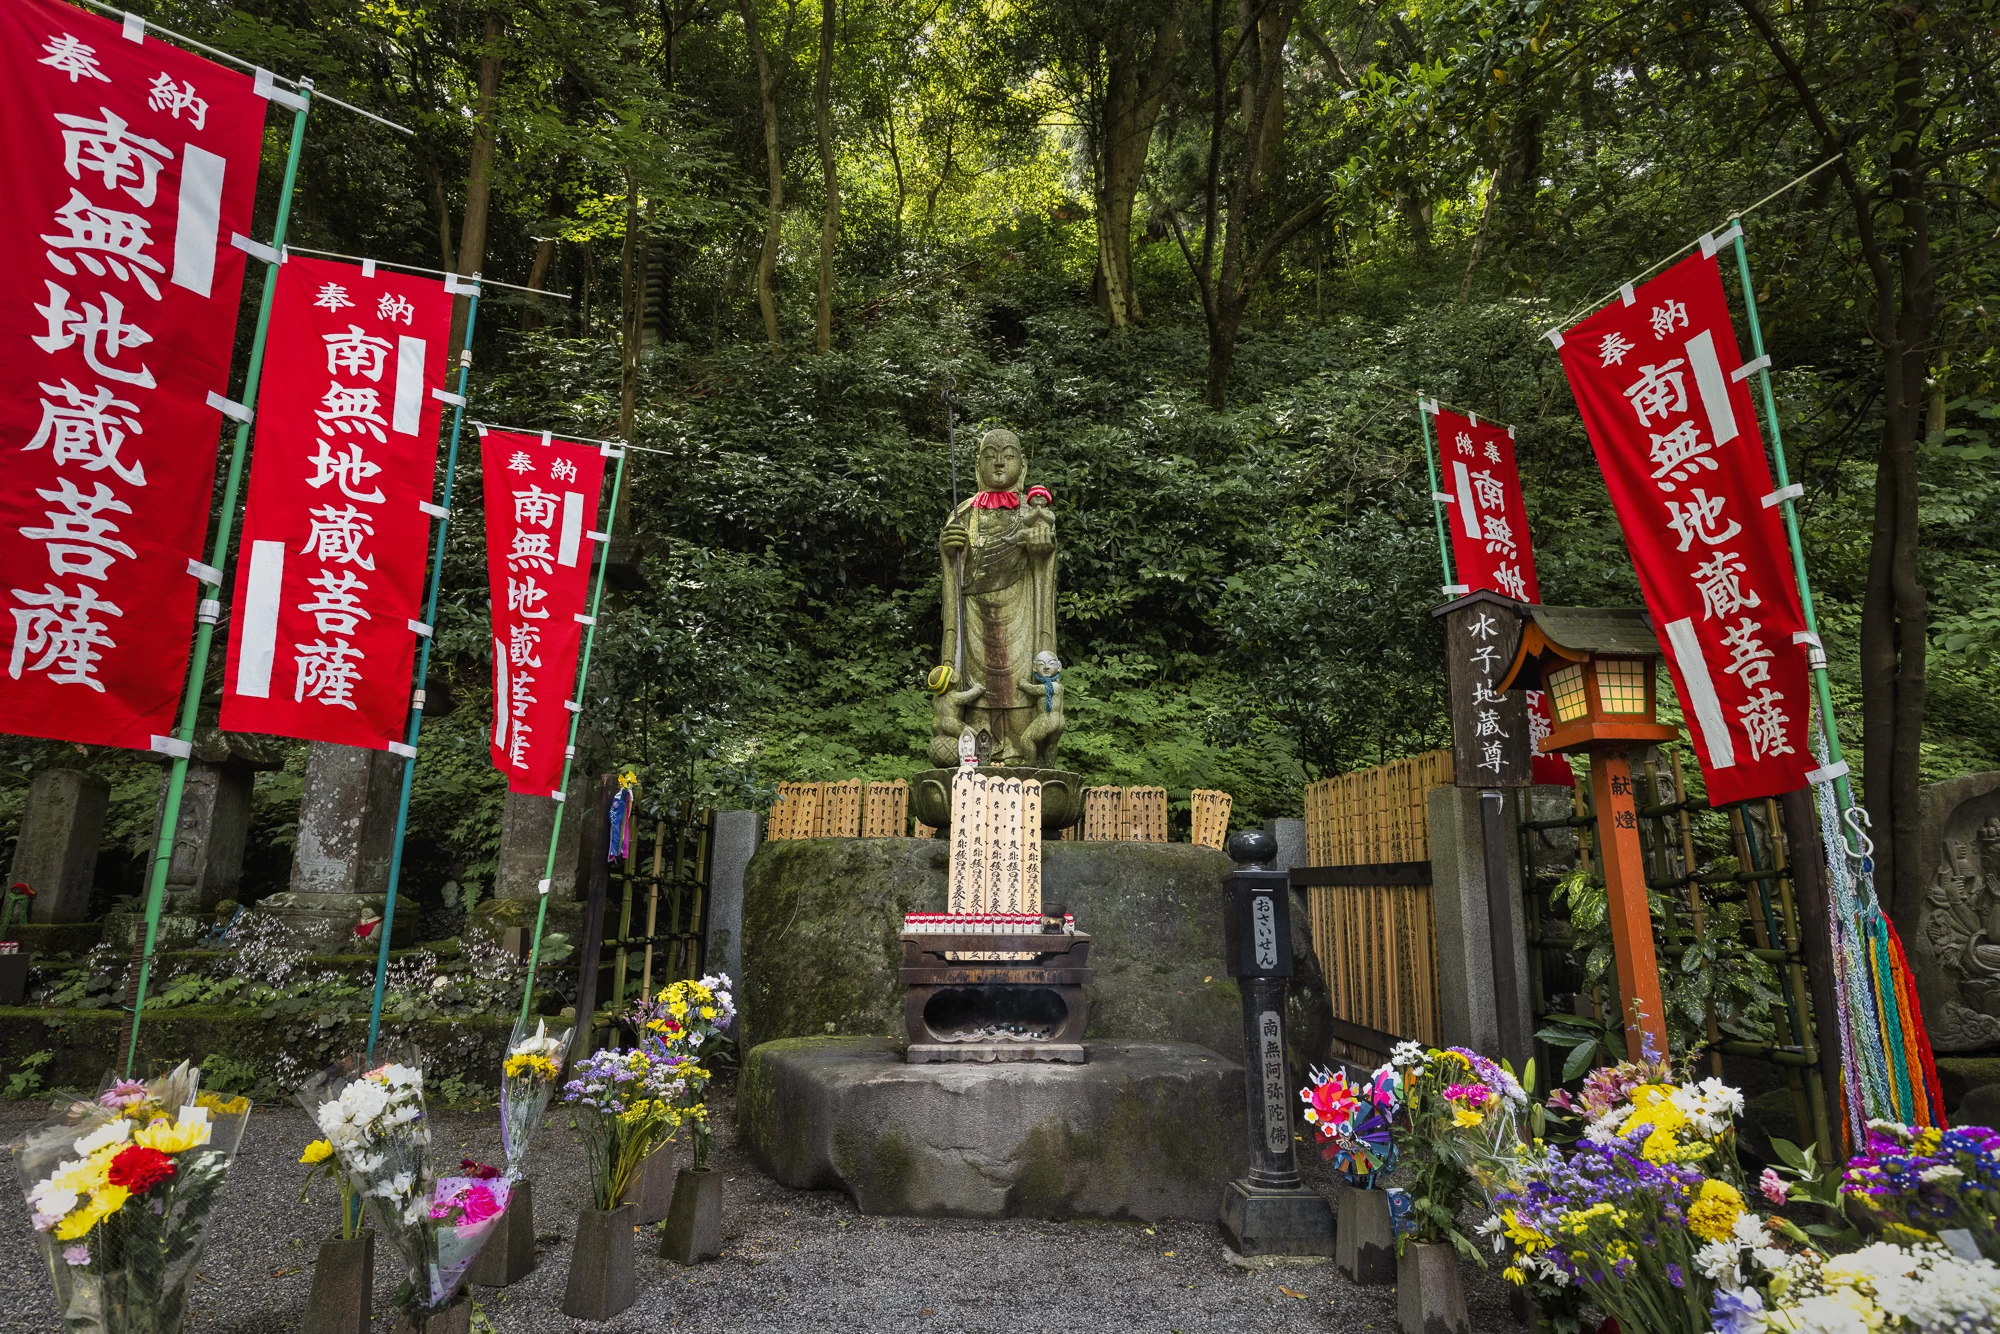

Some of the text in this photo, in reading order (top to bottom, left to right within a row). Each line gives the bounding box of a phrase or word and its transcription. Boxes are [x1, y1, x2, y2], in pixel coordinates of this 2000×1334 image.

[313, 282, 415, 326] 奉納
[1598, 299, 1689, 368] 奉納
[9, 106, 174, 694] 南無地蔵菩薩
[507, 450, 578, 484] 奉納
[293, 324, 394, 711] 南無地蔵菩薩
[1623, 358, 1796, 762] 南無地蔵菩薩
[1467, 612, 1510, 774] 水子地蔵尊
[1611, 774, 1636, 829] 献燈
[1256, 899, 1275, 966] おさいせん
[1263, 1018, 1288, 1144] 南無阿弥陀佛
